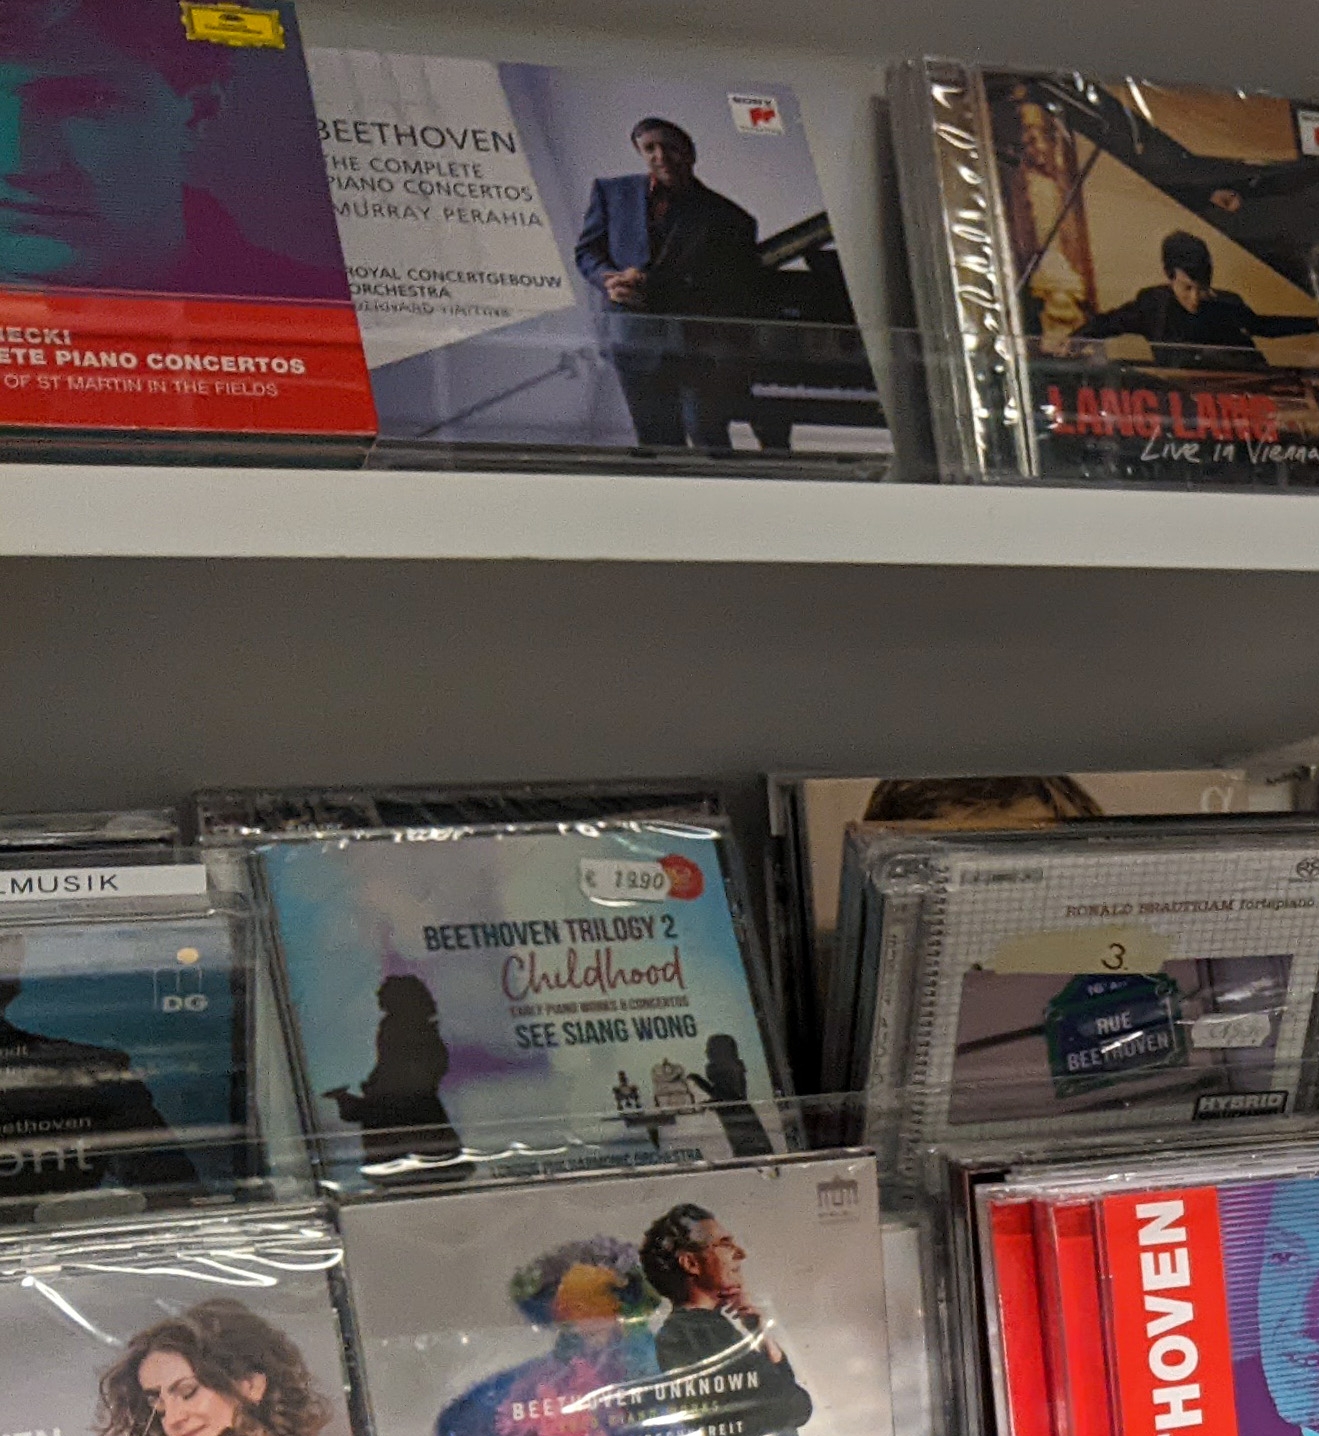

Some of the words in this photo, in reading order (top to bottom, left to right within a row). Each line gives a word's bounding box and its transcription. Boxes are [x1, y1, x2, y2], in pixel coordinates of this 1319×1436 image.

[315, 120, 516, 154] BEETHOVEN
[377, 156, 483, 178] COMPLETE
[403, 178, 533, 201] CONCERTOS
[336, 202, 430, 221] MURRAY
[443, 208, 543, 228] PERAHIA
[56, 352, 139, 369] PIANO
[148, 355, 305, 374] CONCERTOS
[68, 376, 142, 392] MARTIN
[216, 379, 278, 396] FIELDS
[1048, 386, 1161, 438] LANG
[1170, 391, 1278, 442] LANG
[1140, 434, 1198, 462] Live
[1213, 444, 1235, 462] in
[502, 946, 686, 1000] Childhood
[515, 1023, 560, 1048] SEE
[562, 1019, 629, 1045] SIANG
[632, 1014, 698, 1040] WONG
[654, 1371, 759, 1400] UNKNOWN
